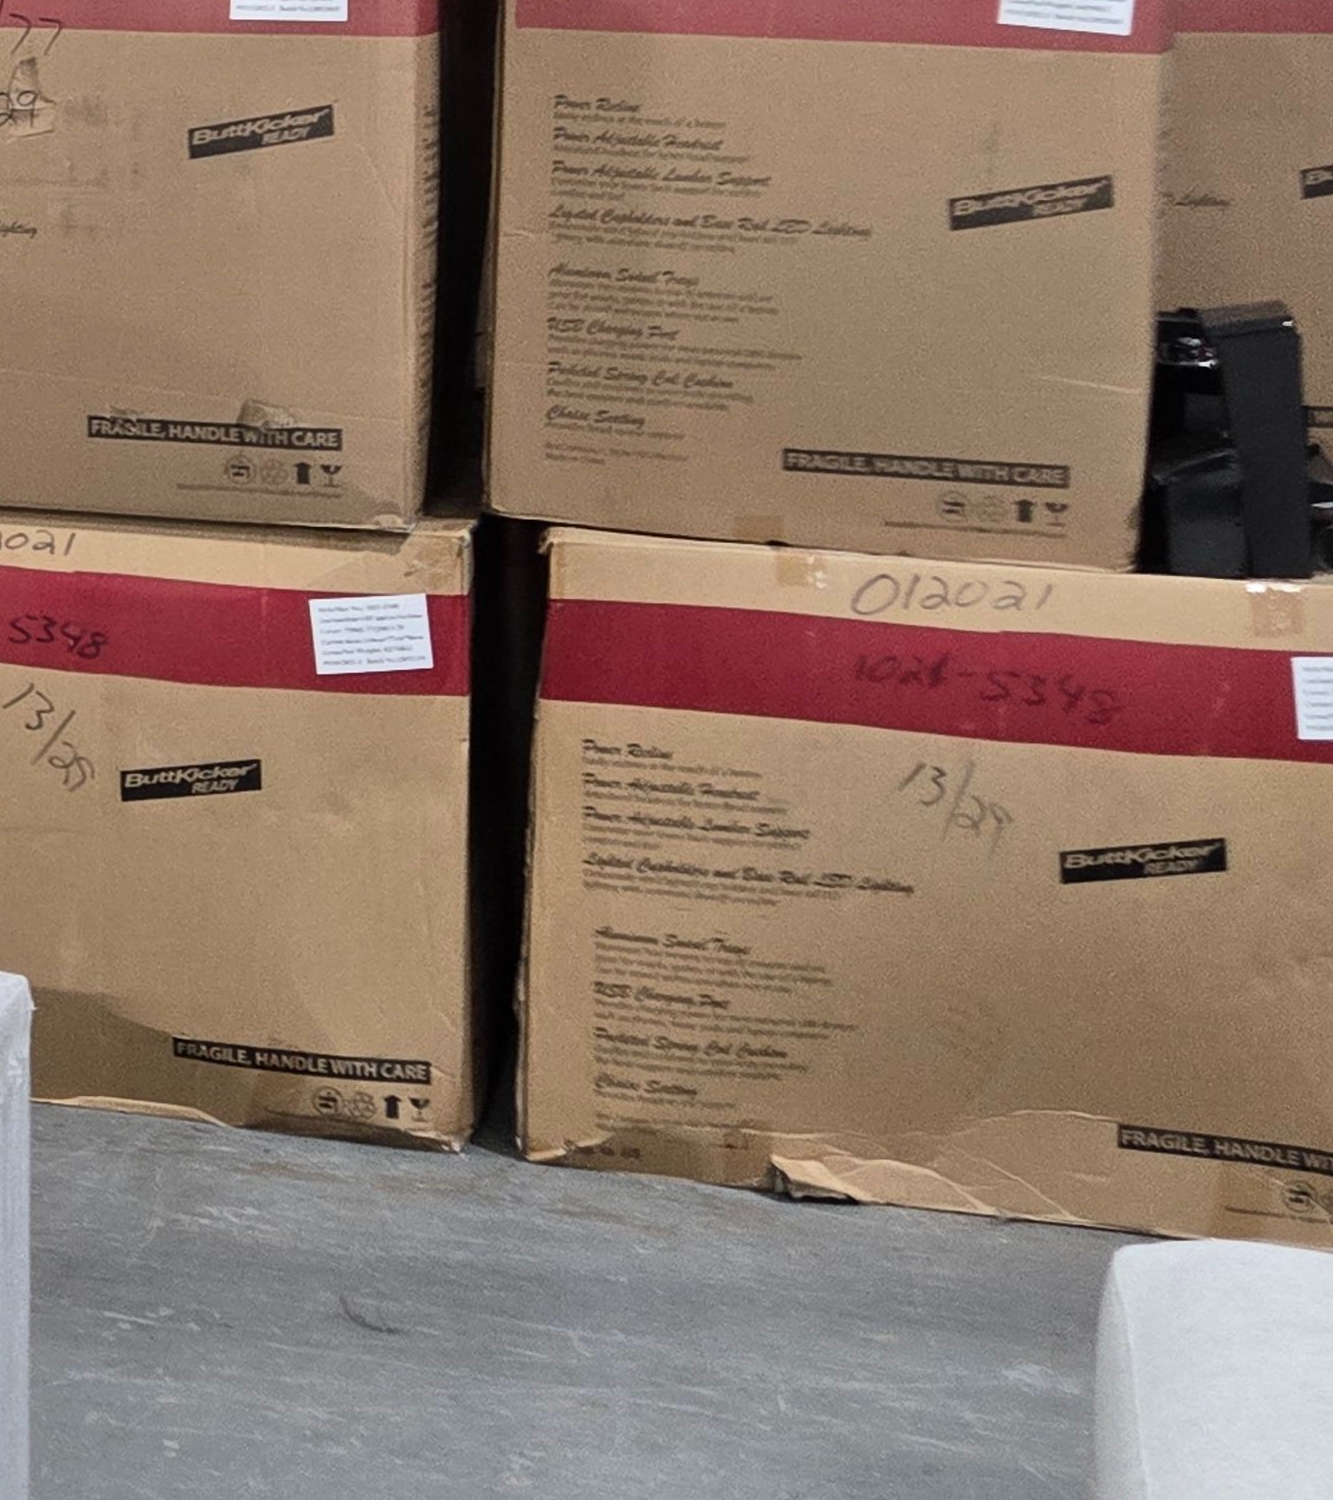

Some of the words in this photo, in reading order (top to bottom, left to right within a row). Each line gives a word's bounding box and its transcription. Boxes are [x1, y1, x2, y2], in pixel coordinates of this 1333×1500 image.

[192, 108, 329, 146] ButtKicker
[261, 127, 311, 145] READY
[168, 423, 236, 442] HANDLE
[292, 430, 339, 447] CARE
[1015, 465, 1065, 485] CARE
[851, 573, 1054, 616] 012021
[125, 762, 257, 788] ButtKicker
[192, 779, 239, 794] READY
[1064, 842, 1222, 869] ButtKicker
[175, 1041, 252, 1066] FRAGILE,
[255, 1049, 328, 1073] HANDLE
[330, 1058, 377, 1077] WITH
[380, 1062, 427, 1080] CARE
[1120, 1129, 1210, 1155] FRAGILE,
[1214, 1140, 1298, 1166] HANDLE
